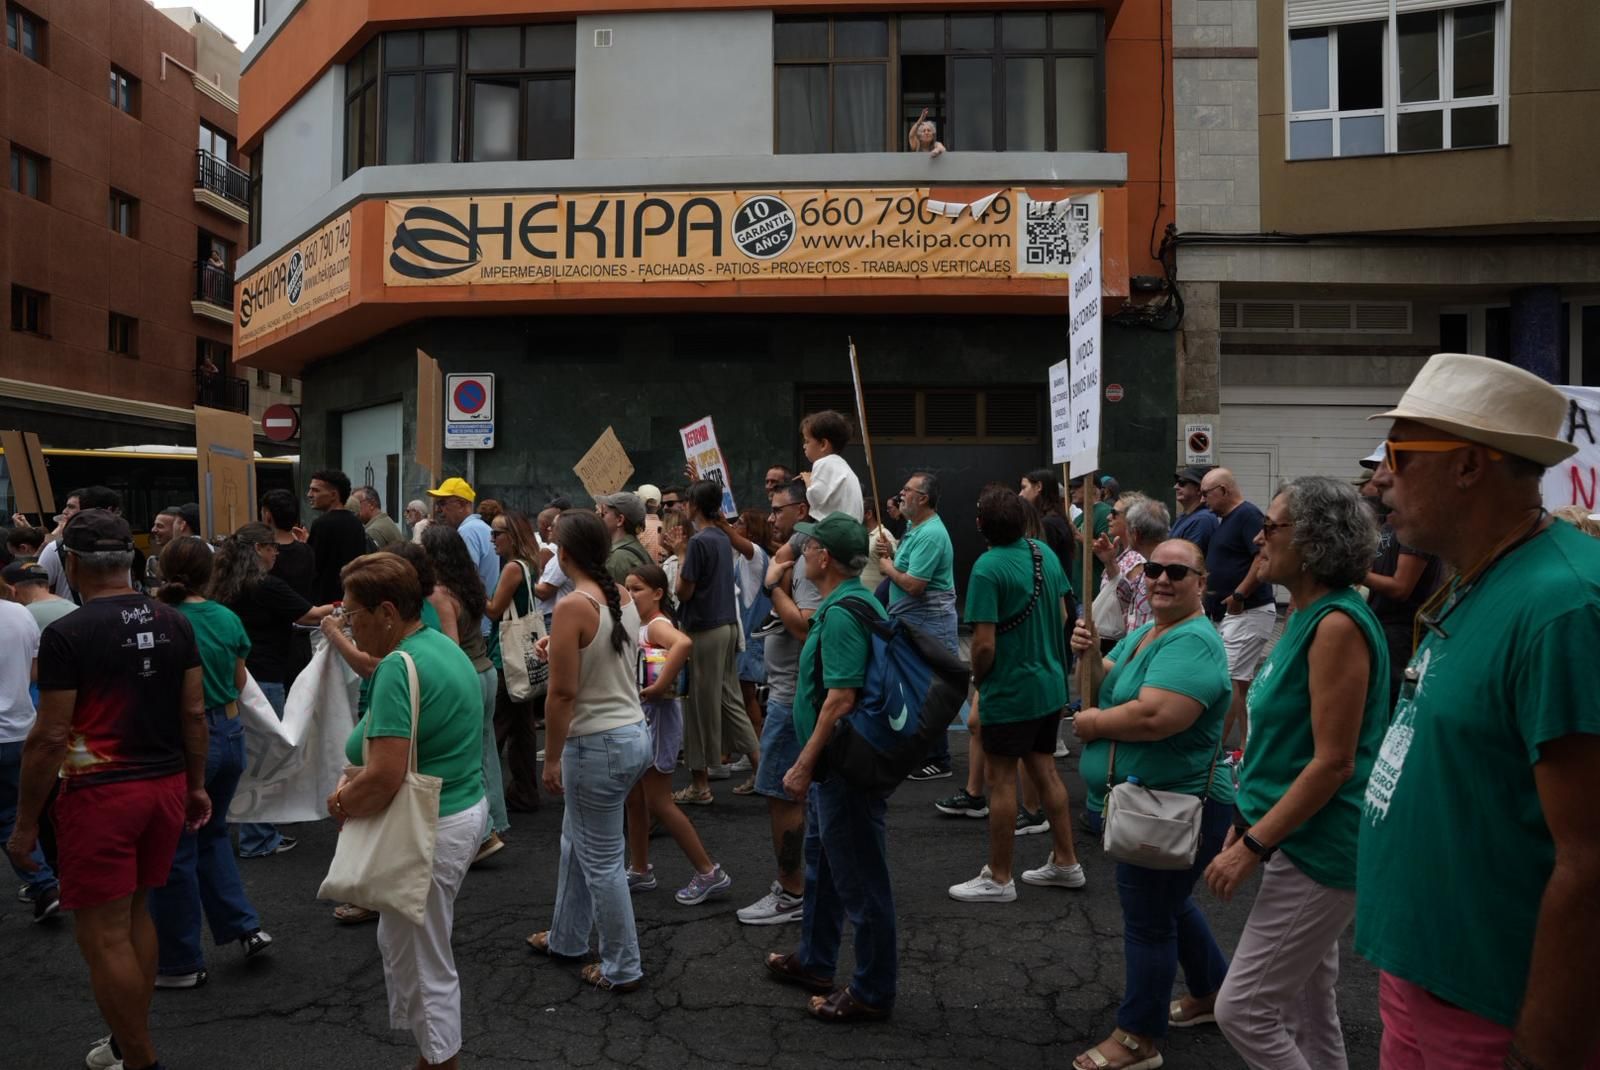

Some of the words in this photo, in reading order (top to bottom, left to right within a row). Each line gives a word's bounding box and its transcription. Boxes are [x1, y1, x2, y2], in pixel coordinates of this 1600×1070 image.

[744, 201, 770, 224] 10
[800, 197, 864, 226] 660
[875, 196, 936, 226] 790
[319, 230, 334, 262] 790
[335, 219, 351, 253] 749
[469, 198, 723, 262] HEKIPA
[755, 230, 789, 254] AÑOS
[801, 229, 1011, 253] www.hekipa.com
[480, 265, 628, 278] IMPERMEABILIZACIONES
[638, 263, 706, 277] FACHADAS
[716, 262, 760, 275] PATIOS
[771, 261, 850, 274] PROYECTOS
[861, 259, 928, 273] TRABAJOS
[932, 259, 1011, 273] VERTICALES
[251, 262, 288, 313] HEKIPA
[1075, 267, 1092, 299] BARRIO
[1076, 408, 1090, 433] LPGC
